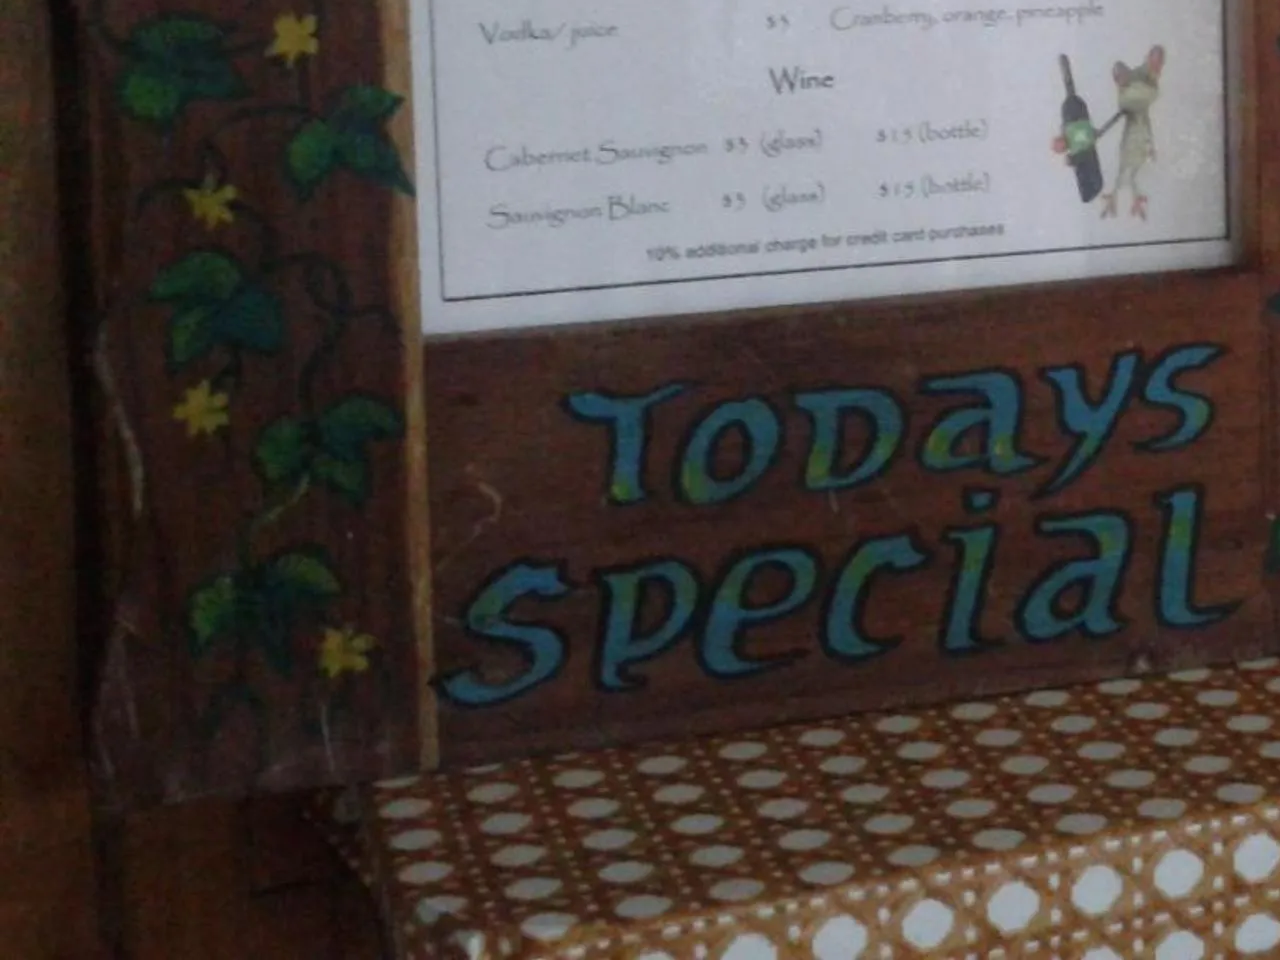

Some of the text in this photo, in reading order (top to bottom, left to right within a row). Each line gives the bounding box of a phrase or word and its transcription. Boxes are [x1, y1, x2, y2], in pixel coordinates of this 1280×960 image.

[768, 66, 834, 94] Wine
[484, 144, 592, 171] Cabernet
[759, 129, 824, 159] (glass)
[917, 118, 990, 145] (bottle)
[606, 195, 671, 222] Blanc
[761, 183, 826, 213] (glass)
[919, 172, 992, 199] (bottle)
[646, 246, 681, 262] 10%
[685, 240, 761, 259] additional
[764, 237, 817, 254] charge
[821, 234, 843, 248] for
[846, 230, 889, 247] credit
[892, 227, 926, 243] card
